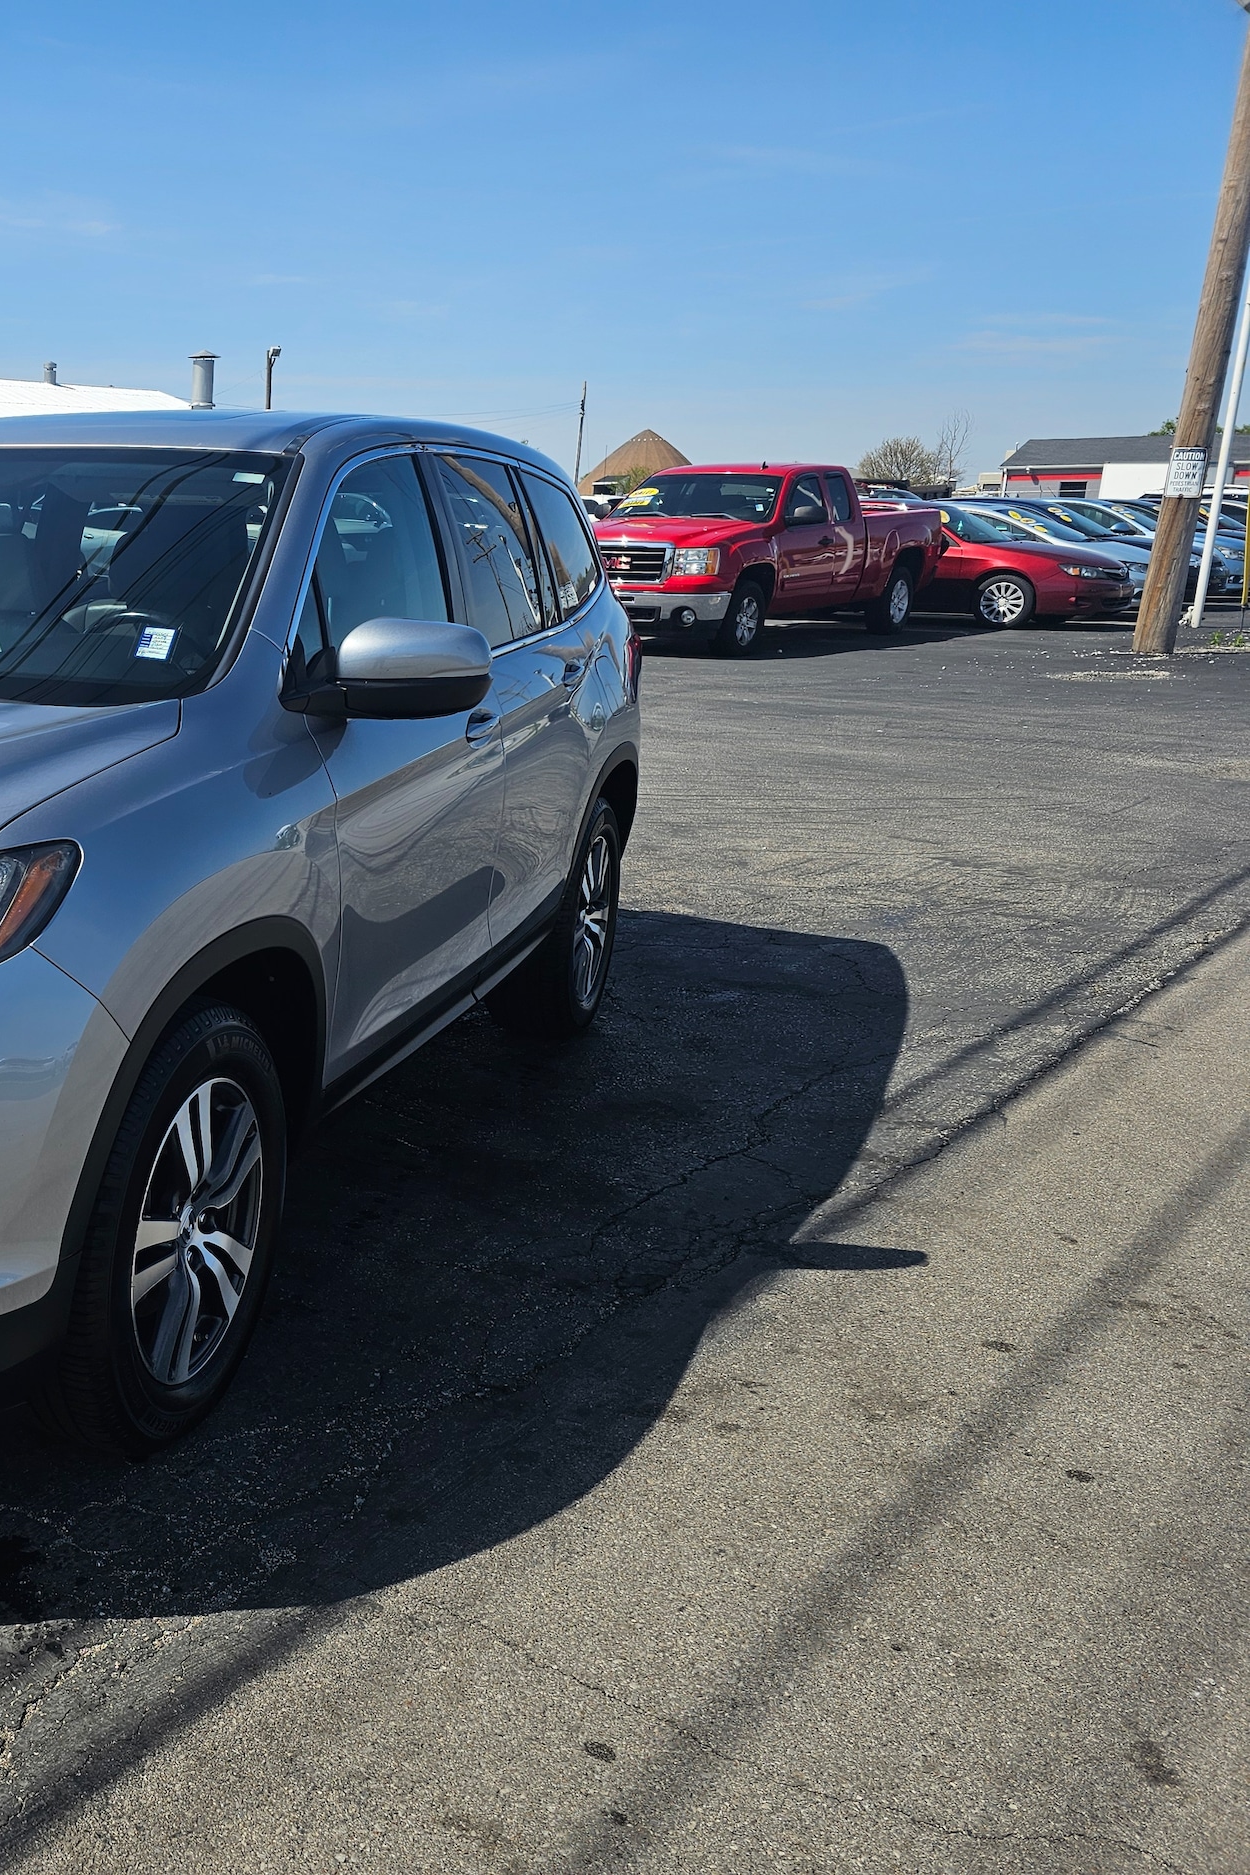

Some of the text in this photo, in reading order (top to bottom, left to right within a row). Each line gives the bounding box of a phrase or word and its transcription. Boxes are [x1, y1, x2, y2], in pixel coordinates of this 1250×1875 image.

[1173, 452, 1205, 460] CAUTION
[1176, 462, 1199, 471] SLOW
[1174, 472, 1198, 480] DOWN
[601, 556, 632, 569] MC
[231, 1035, 271, 1071] MICHELIN
